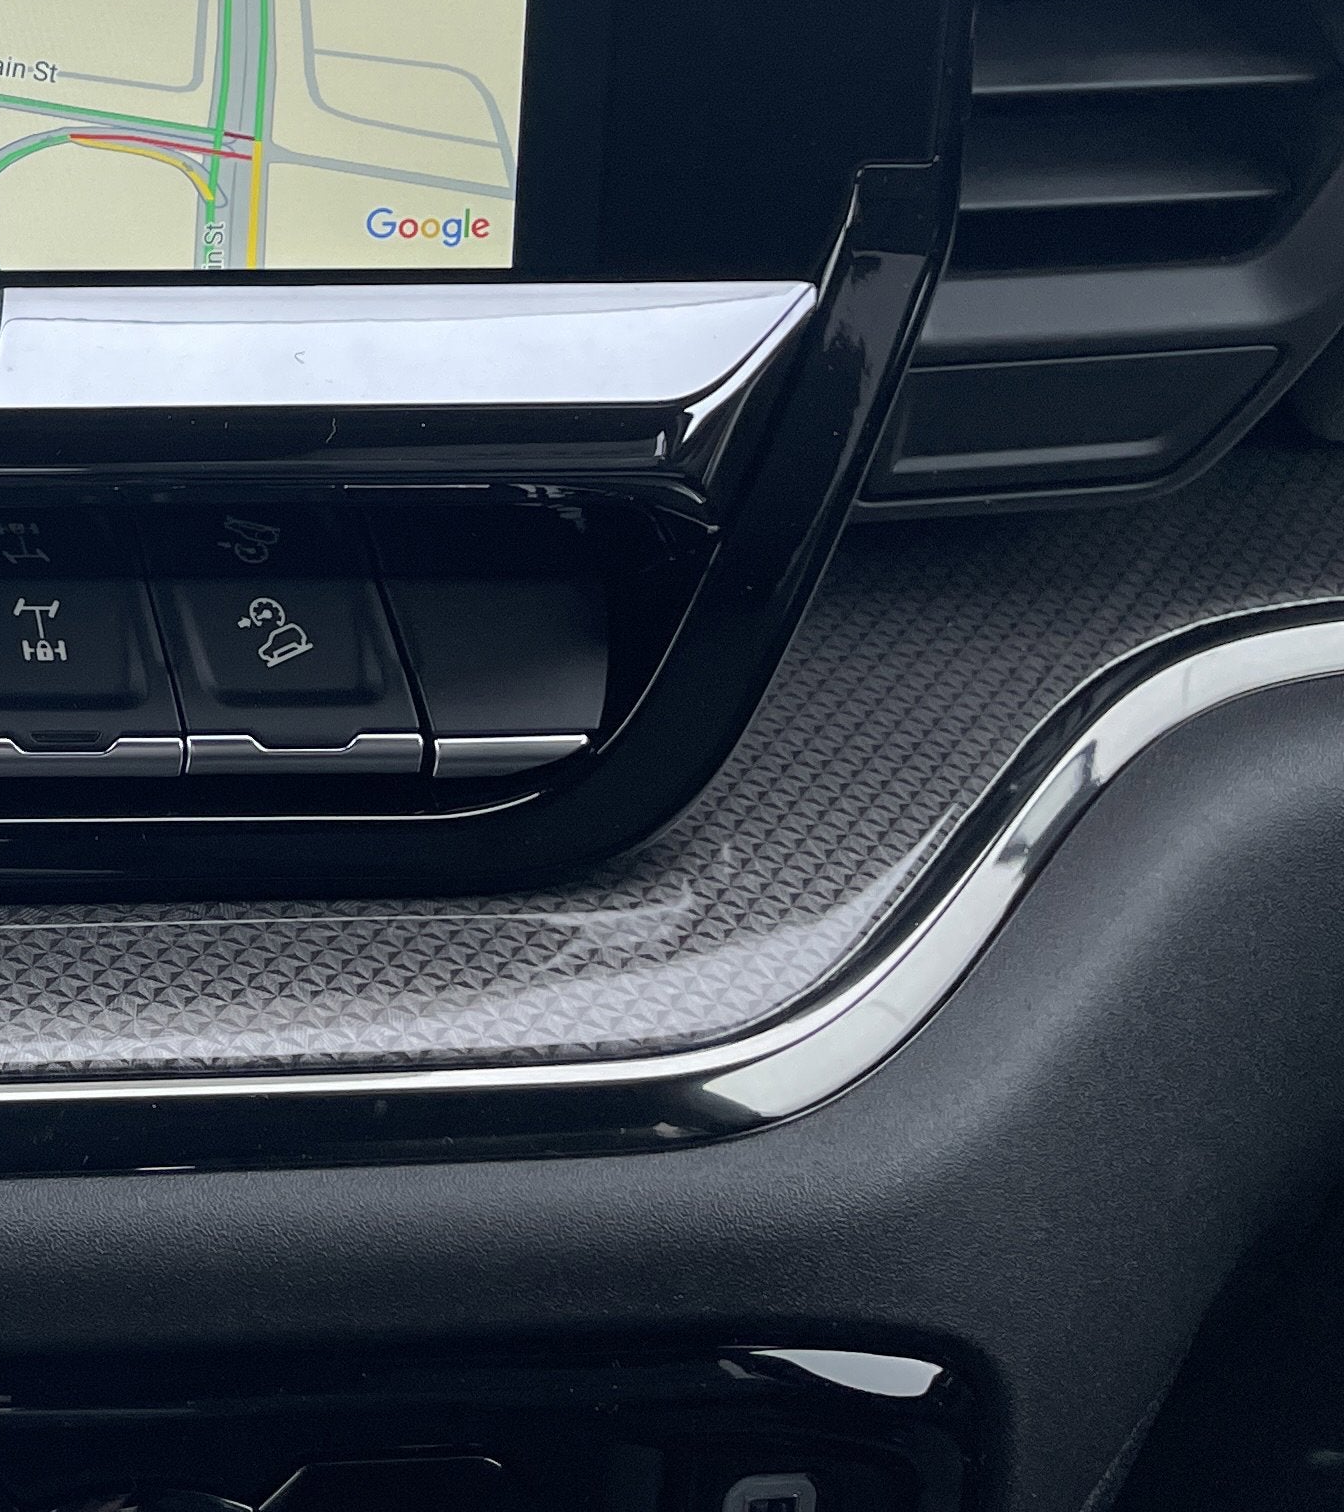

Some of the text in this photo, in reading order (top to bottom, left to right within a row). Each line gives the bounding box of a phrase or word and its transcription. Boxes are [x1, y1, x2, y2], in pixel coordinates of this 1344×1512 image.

[32, 59, 58, 84] St
[204, 224, 224, 244] St
[366, 207, 490, 247] Google
